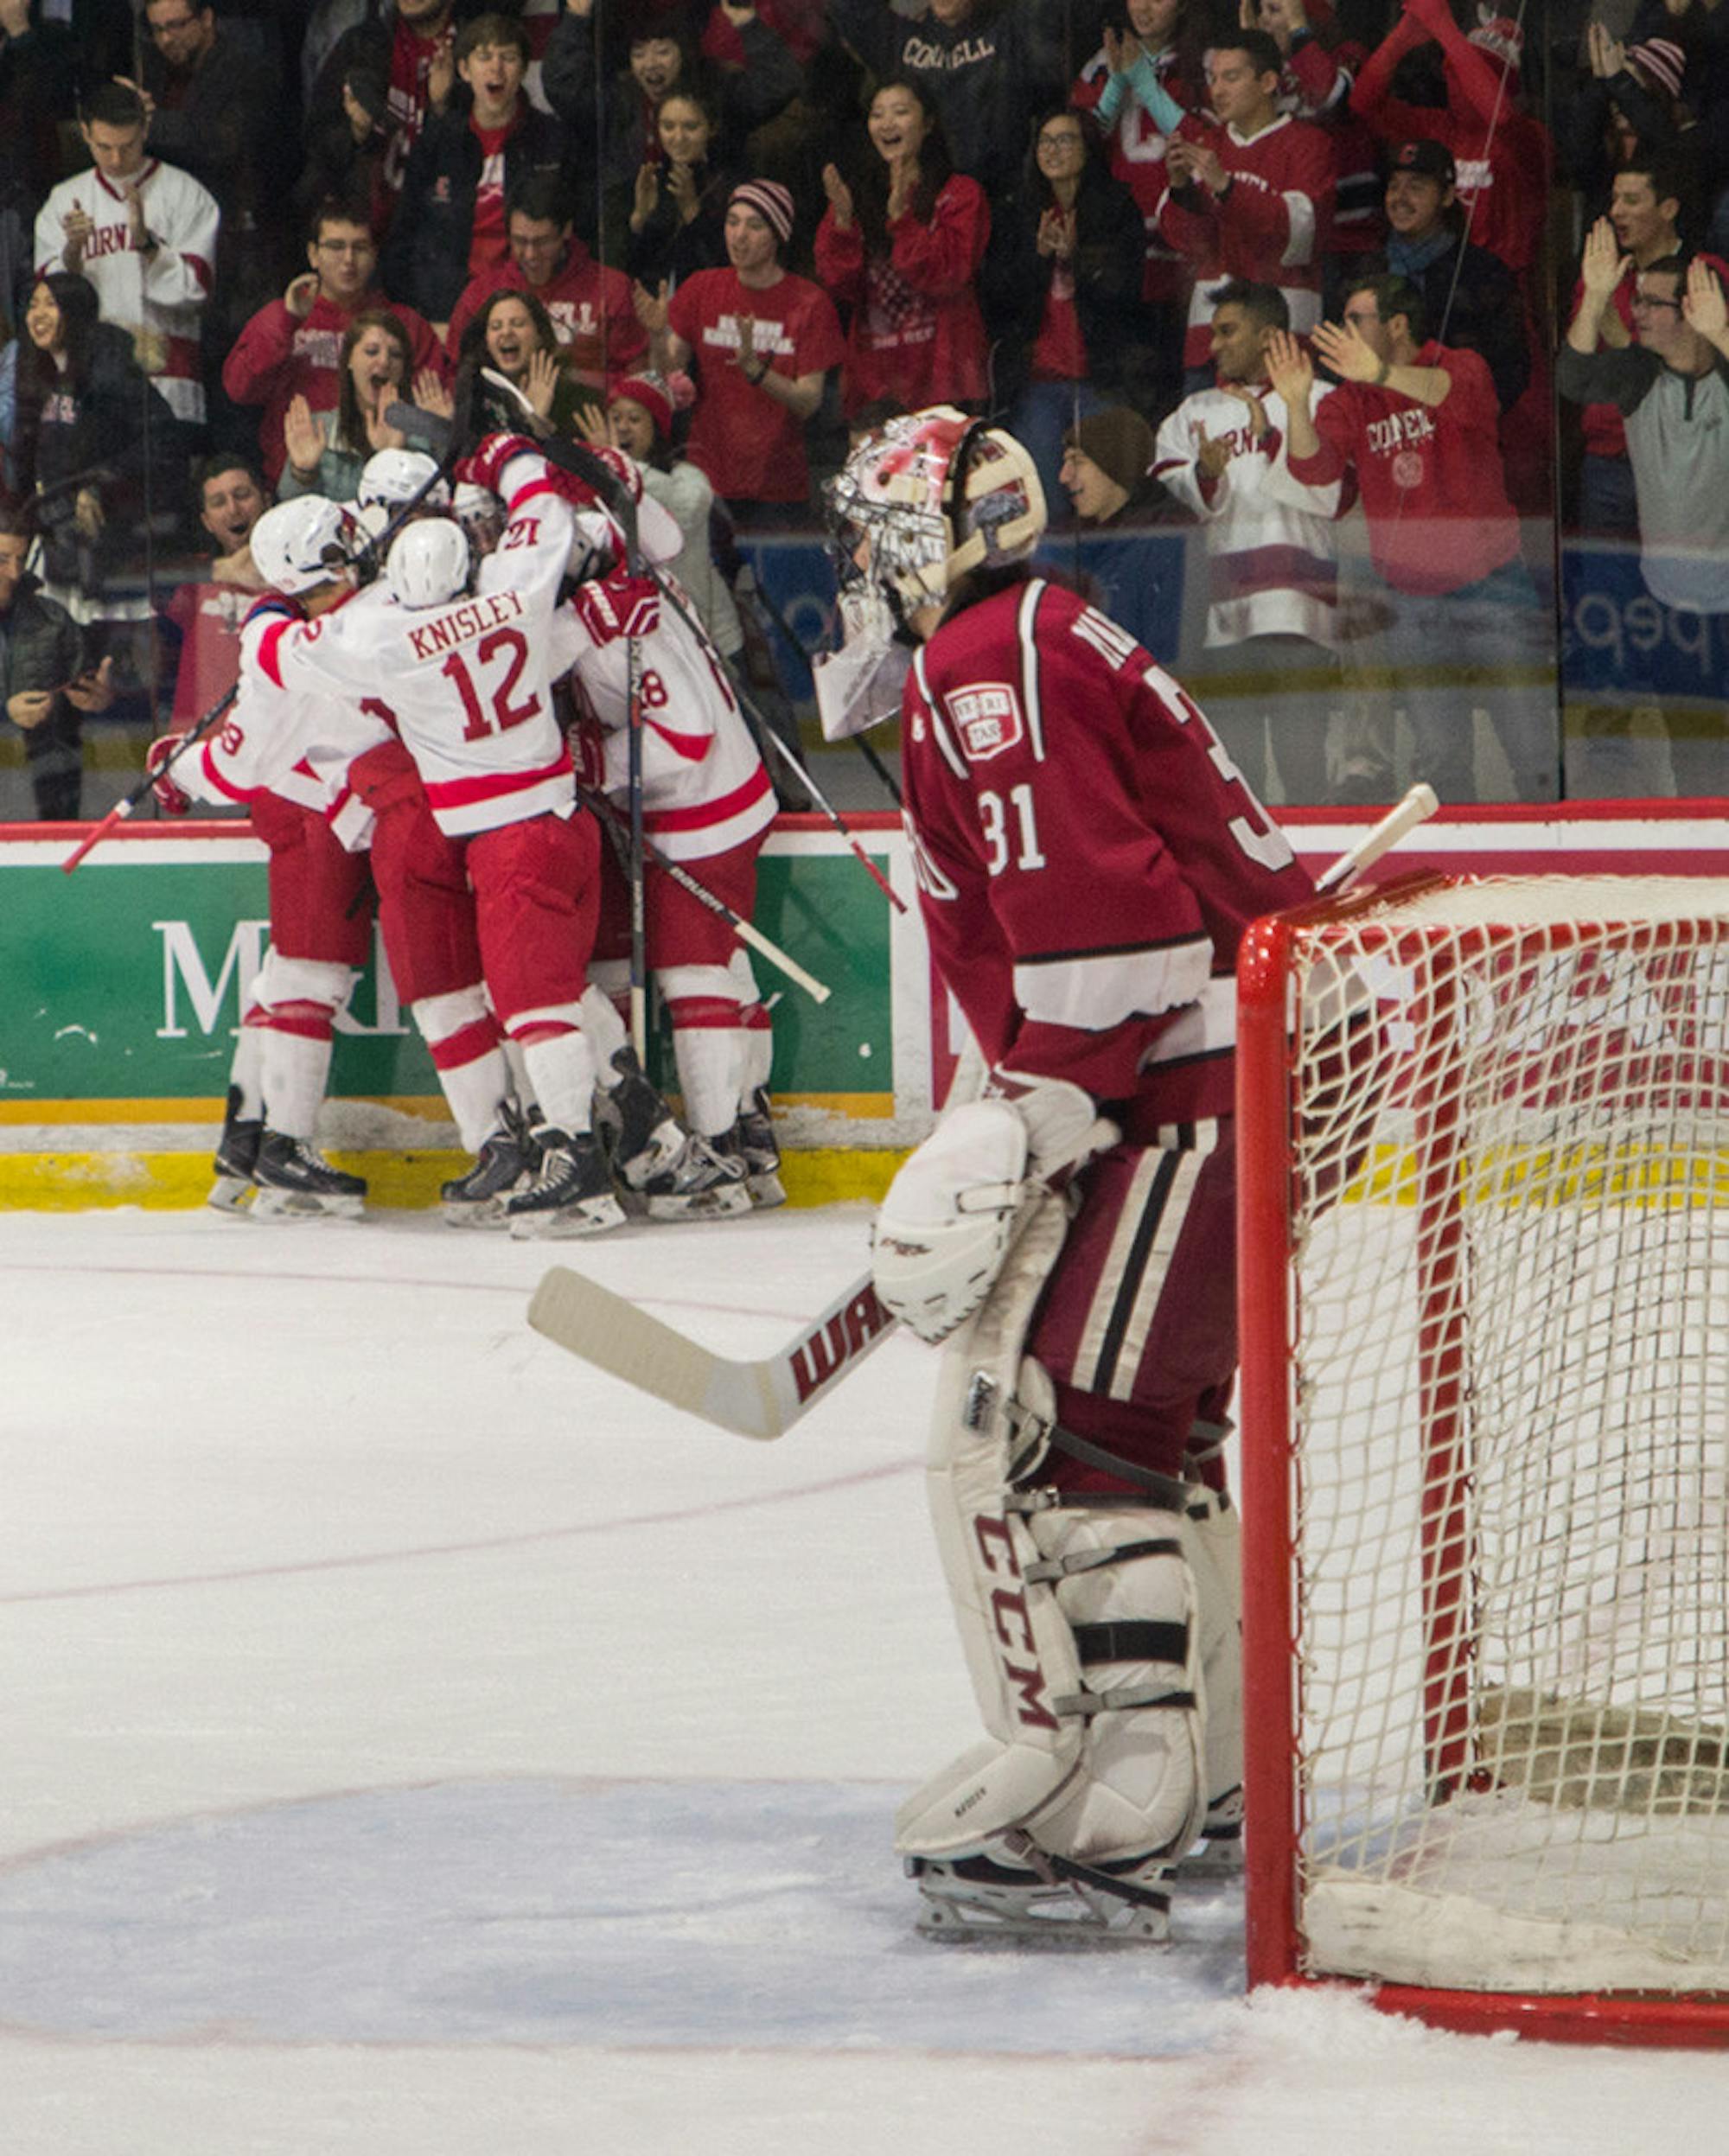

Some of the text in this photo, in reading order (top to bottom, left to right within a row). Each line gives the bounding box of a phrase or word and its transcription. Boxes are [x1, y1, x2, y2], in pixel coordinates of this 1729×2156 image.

[408, 590, 523, 660] KNISLEY
[441, 627, 543, 743] 12
[979, 783, 1045, 876] 31
[973, 1514, 1061, 1732] CCM
